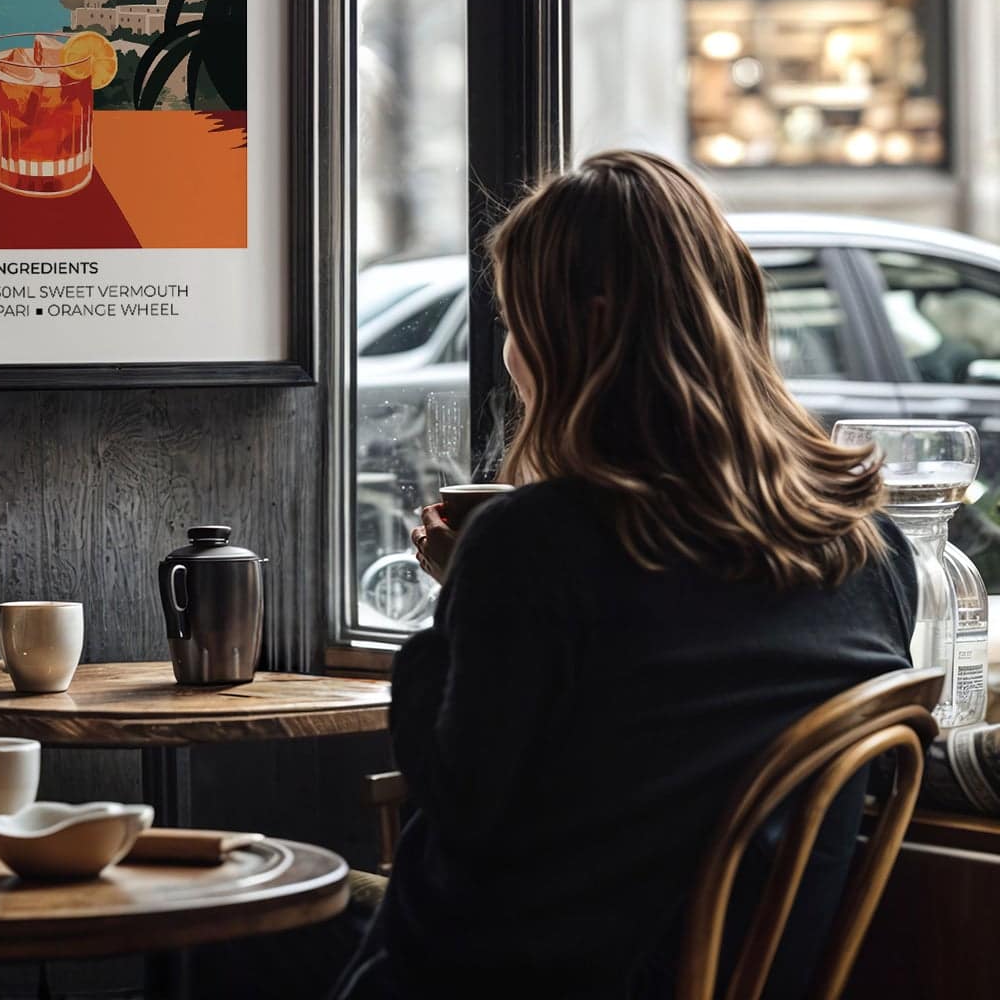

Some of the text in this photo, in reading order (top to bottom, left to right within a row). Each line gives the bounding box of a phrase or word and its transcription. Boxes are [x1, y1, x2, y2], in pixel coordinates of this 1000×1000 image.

[39, 285, 95, 299] SWEET
[97, 284, 189, 298] VERMOUTH
[47, 303, 117, 317] ORANGE
[120, 302, 180, 317] WHEEL
